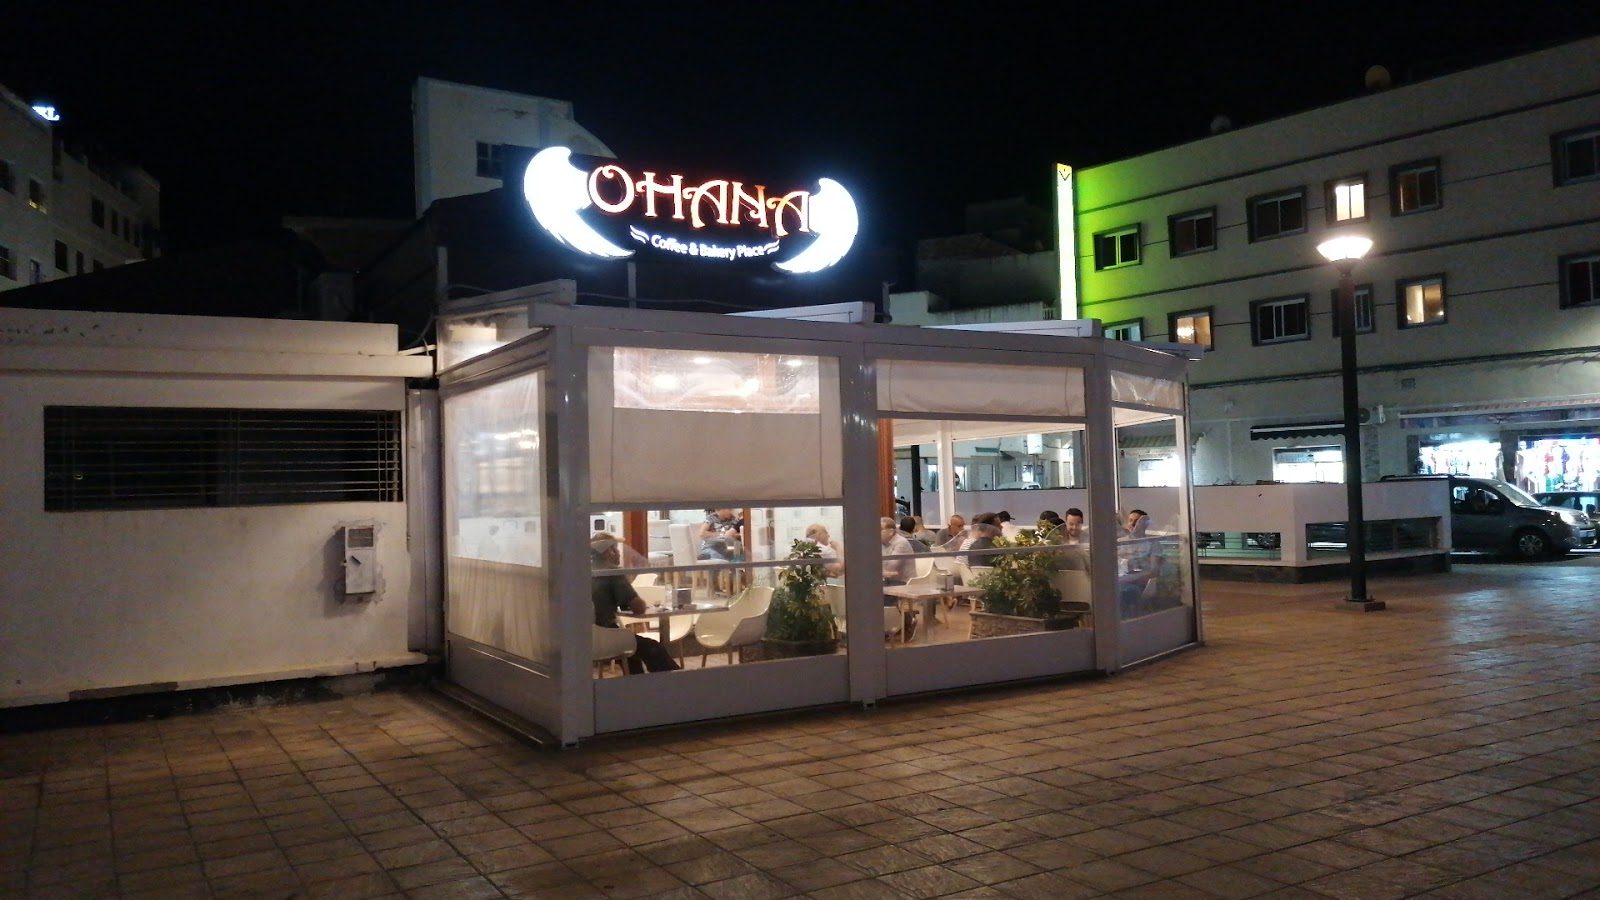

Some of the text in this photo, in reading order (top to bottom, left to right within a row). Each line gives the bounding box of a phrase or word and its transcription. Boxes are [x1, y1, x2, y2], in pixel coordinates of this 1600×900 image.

[589, 165, 810, 236] OHANA
[651, 234, 764, 261] Coffee & Bakery Place
